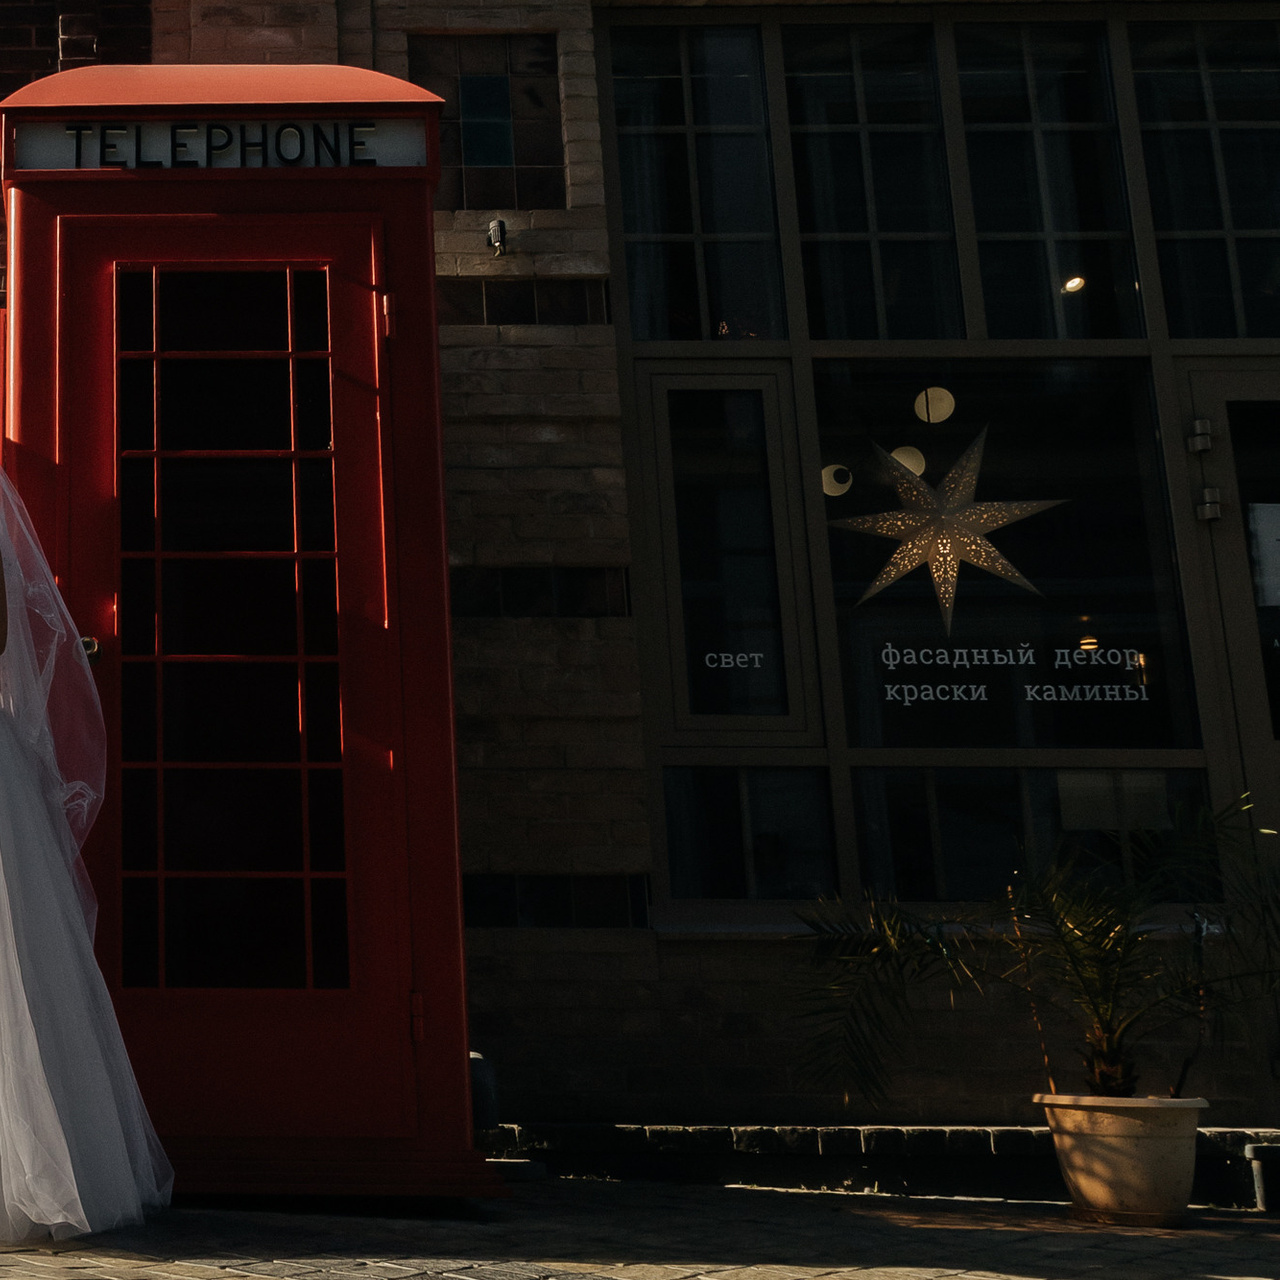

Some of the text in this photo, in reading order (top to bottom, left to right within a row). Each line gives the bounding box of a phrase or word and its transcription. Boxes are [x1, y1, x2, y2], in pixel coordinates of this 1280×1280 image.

[66, 122, 377, 168] TELEPHONE
[704, 649, 765, 669] свет
[880, 642, 1142, 671] фасадный декор
[884, 682, 1151, 707] краски камины
